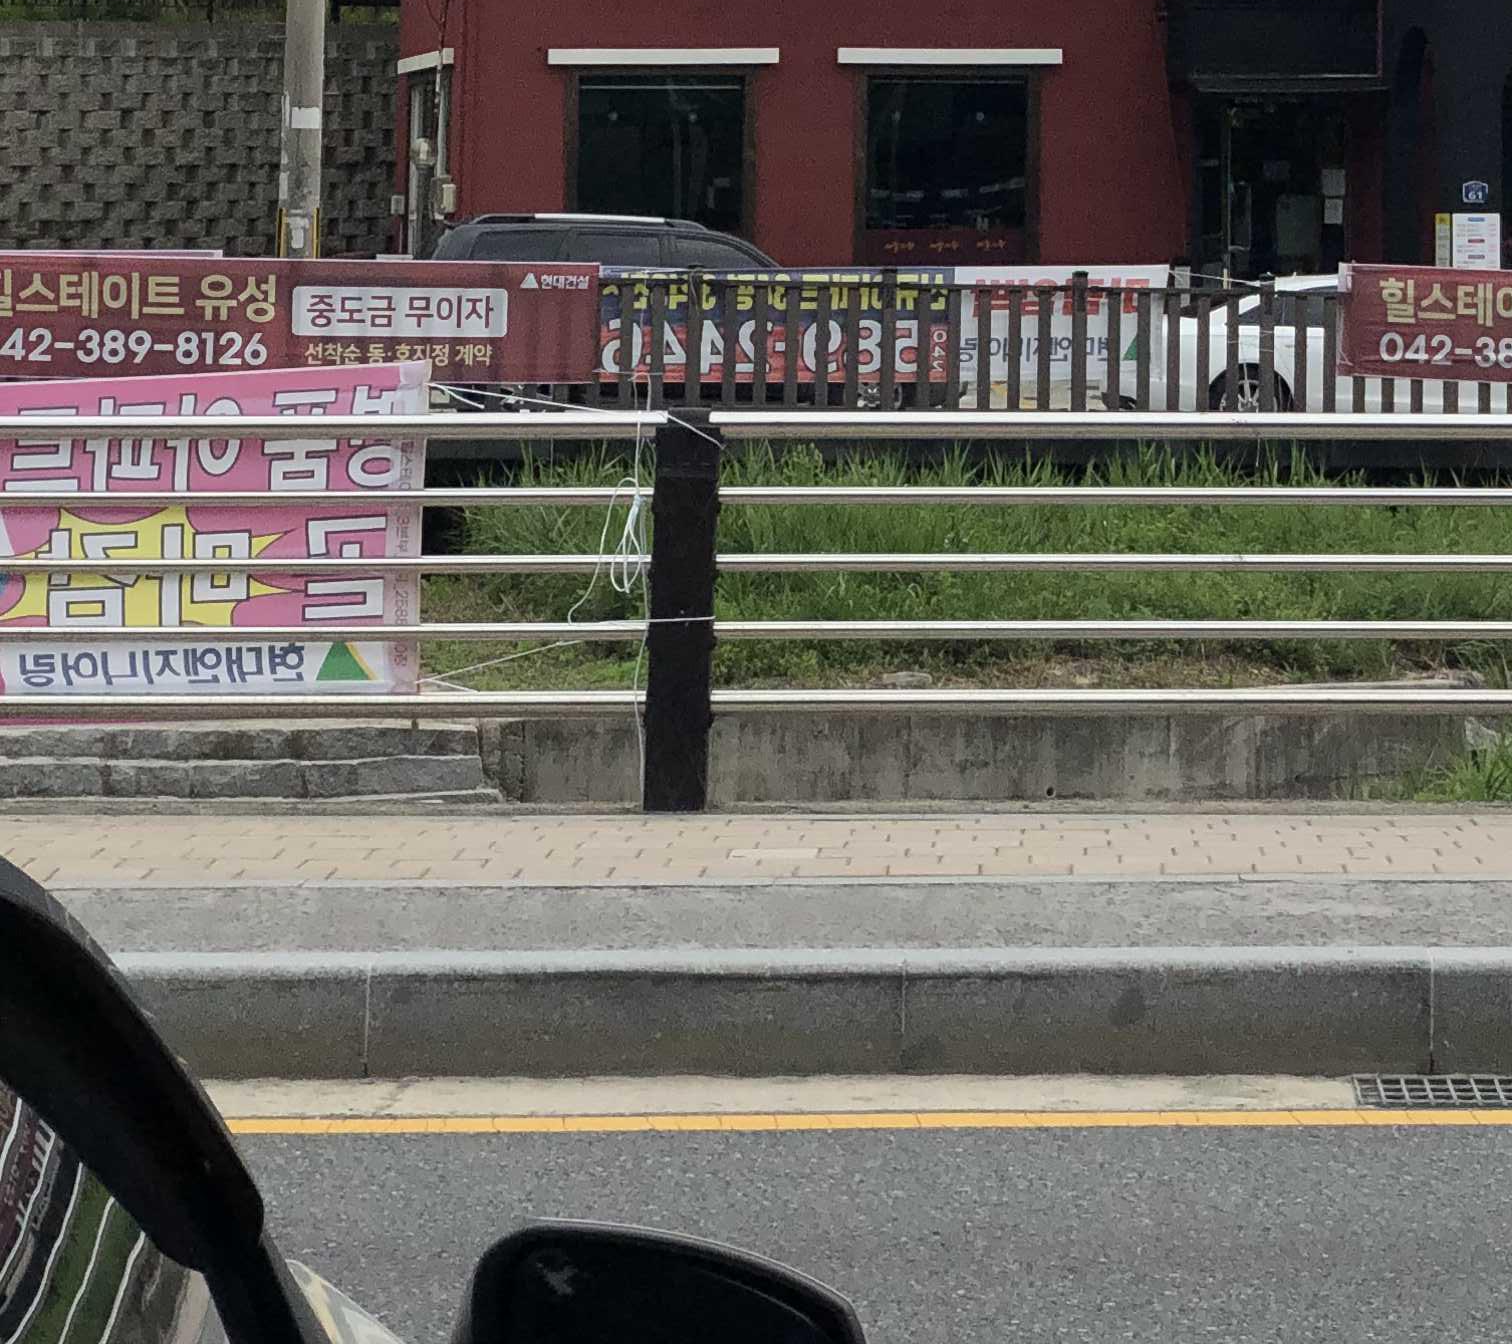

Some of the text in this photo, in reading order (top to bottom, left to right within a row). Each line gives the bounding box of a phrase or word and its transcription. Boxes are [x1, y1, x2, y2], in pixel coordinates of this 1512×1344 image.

[540, 275, 590, 290] 현대건설
[195, 273, 277, 324] 유성
[306, 293, 495, 329] 중도금 무이자
[303, 342, 362, 365] 선착순
[454, 343, 494, 368] 계약
